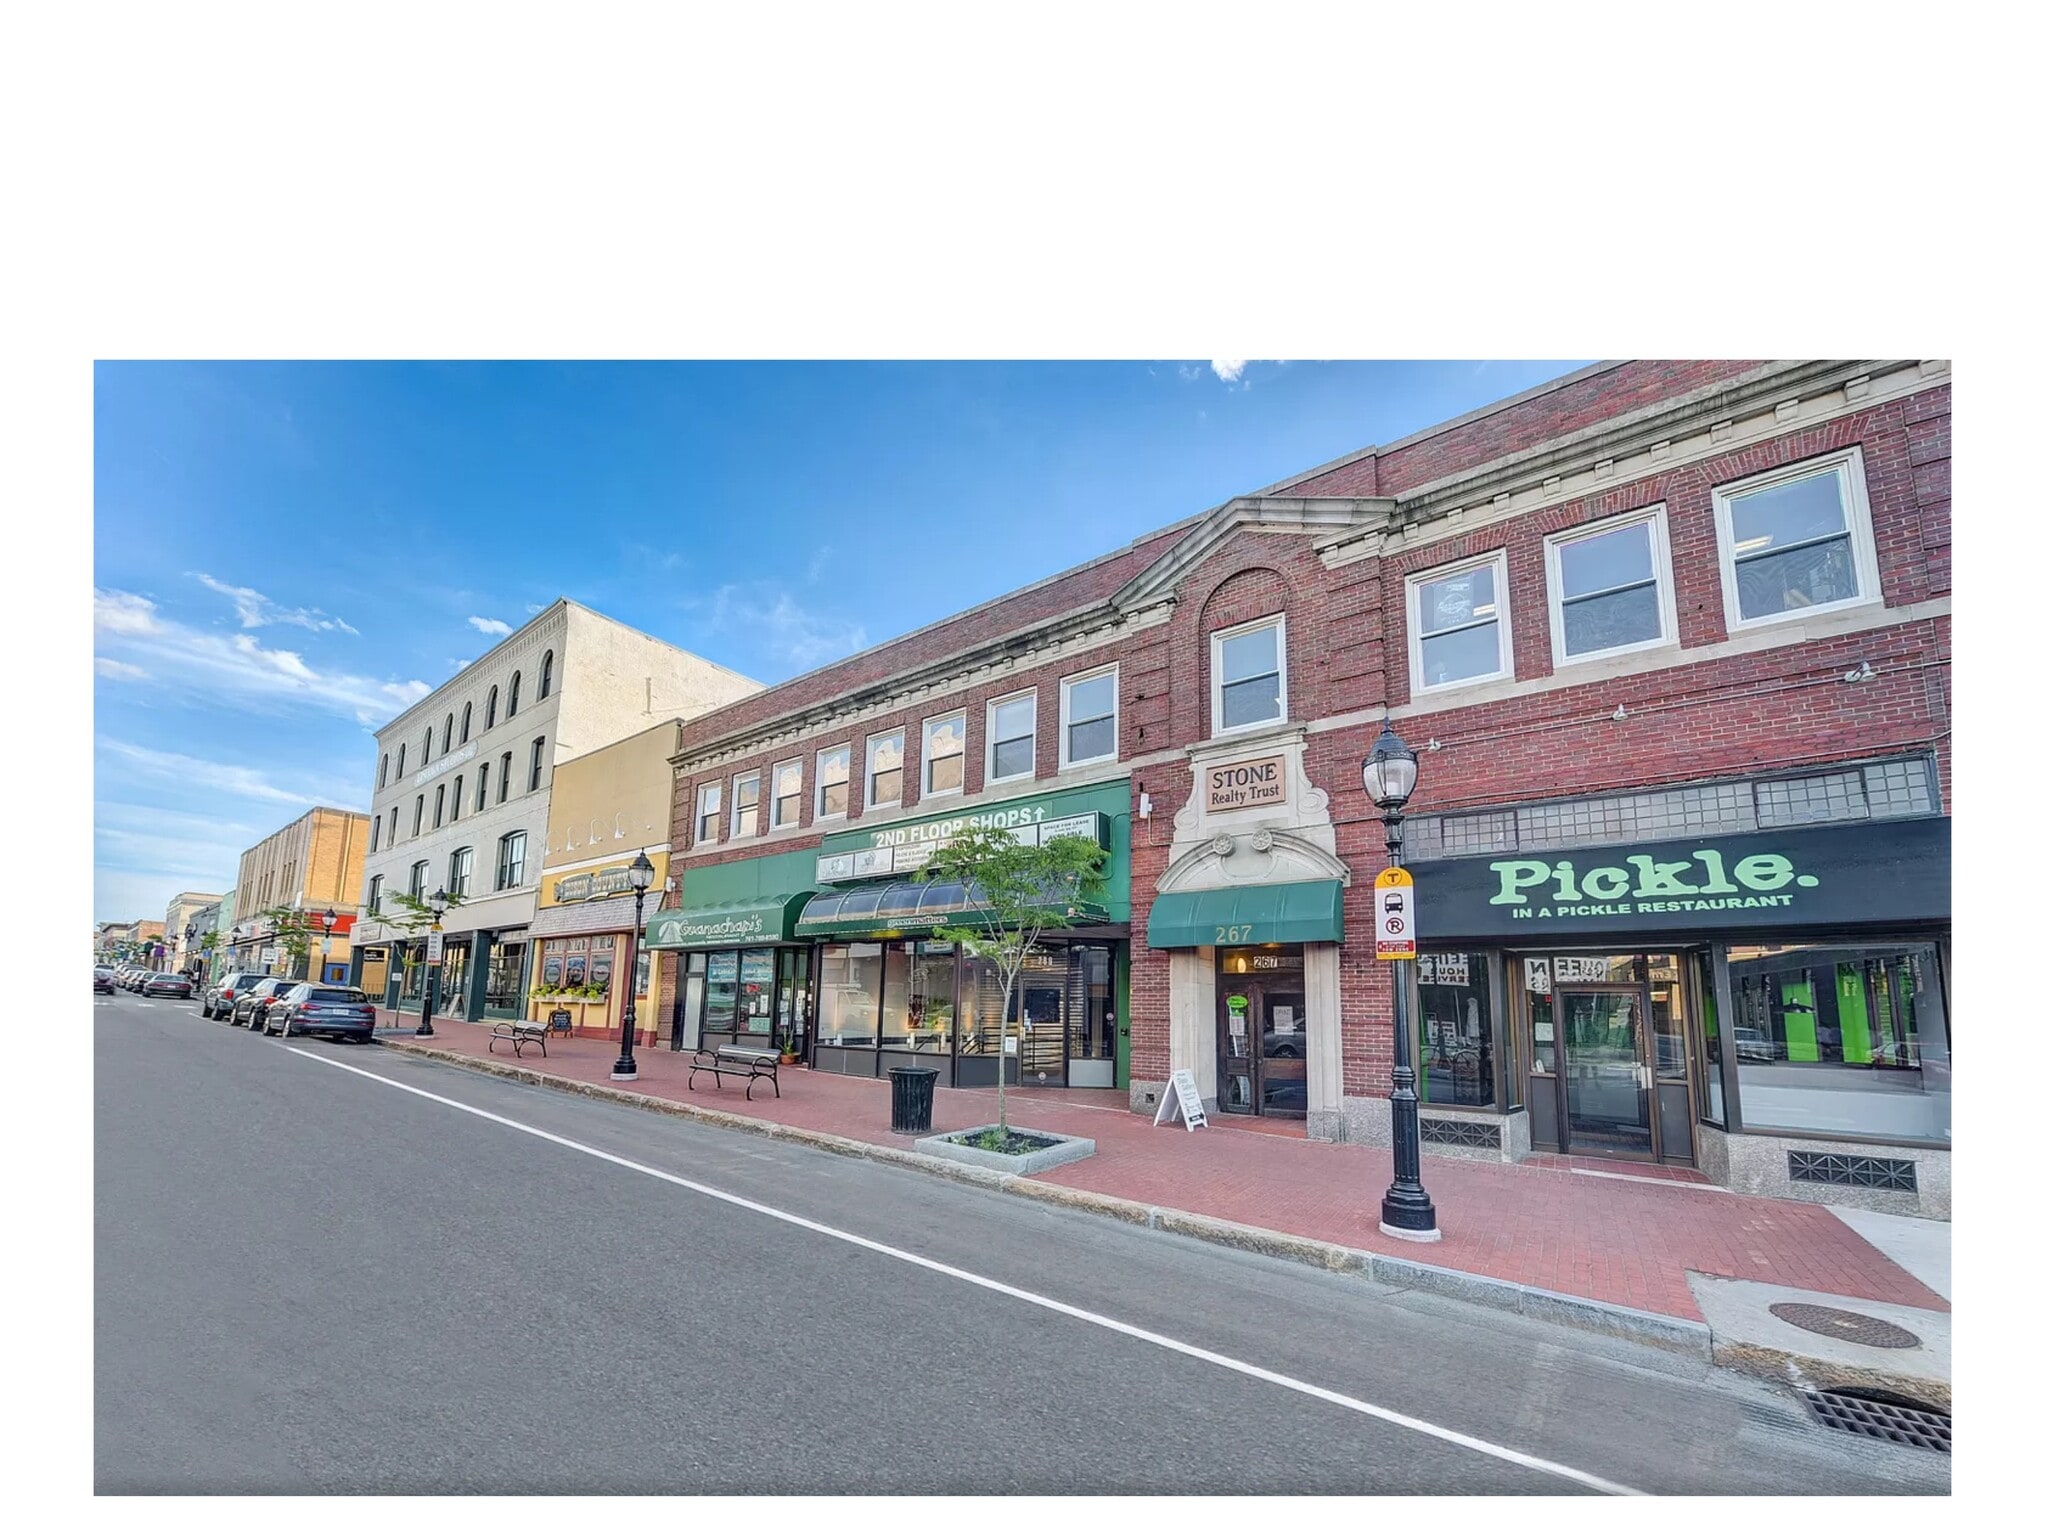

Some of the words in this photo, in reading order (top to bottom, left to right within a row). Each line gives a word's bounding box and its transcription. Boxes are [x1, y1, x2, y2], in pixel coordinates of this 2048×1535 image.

[1212, 762, 1278, 789] STONE
[1211, 789, 1247, 805] Realty
[1248, 783, 1280, 799] Trust
[876, 830, 906, 848] 2ND
[910, 819, 964, 843] FLOOR
[969, 807, 1033, 829] SHOPS
[1489, 850, 1820, 905] Pickle.
[1512, 907, 1533, 919] IN
[1537, 906, 1553, 918] A
[1557, 903, 1632, 917] PICKLE
[1637, 894, 1794, 914] RESTAURANT
[1215, 925, 1252, 943] 267
[1253, 955, 1278, 969] 267
